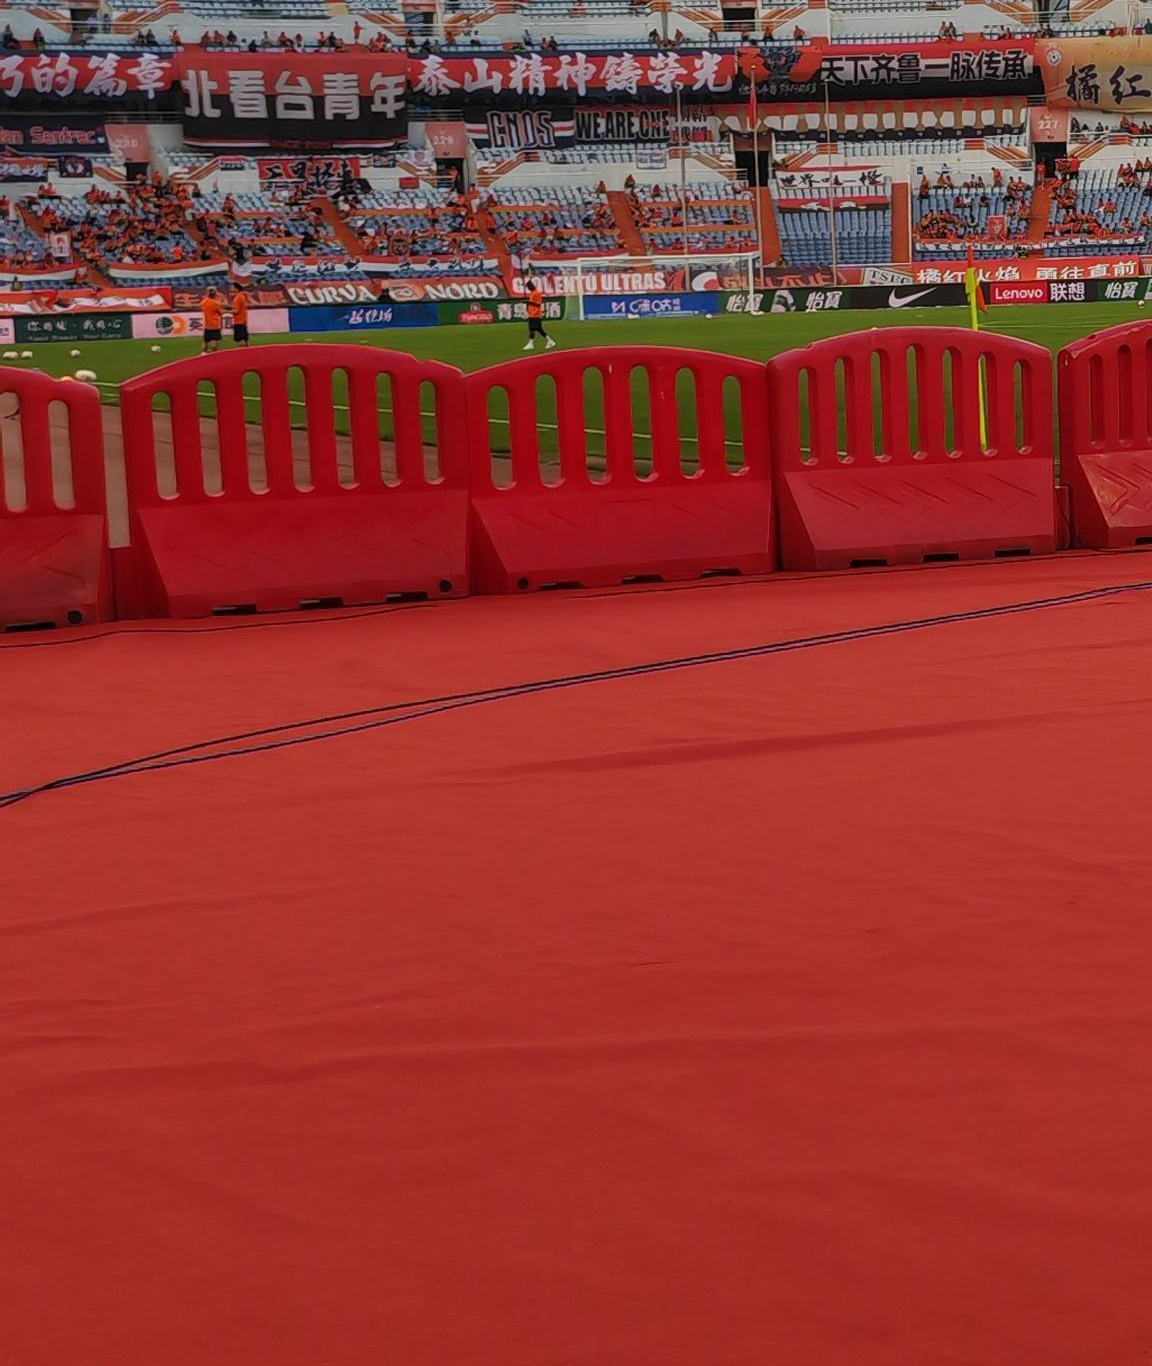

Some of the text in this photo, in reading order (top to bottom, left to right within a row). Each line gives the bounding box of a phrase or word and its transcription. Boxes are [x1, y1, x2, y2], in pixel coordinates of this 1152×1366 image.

[821, 49, 1028, 85] 天下齐鲁一脉传承
[181, 69, 406, 120] 北看台青年
[576, 111, 601, 141] WE
[605, 110, 635, 140] ARE
[601, 270, 667, 292] ULTRAS
[995, 282, 1085, 301] Lenovo 联想
[287, 282, 499, 304] CURVA NORD
[497, 301, 561, 320] 青岛酒
